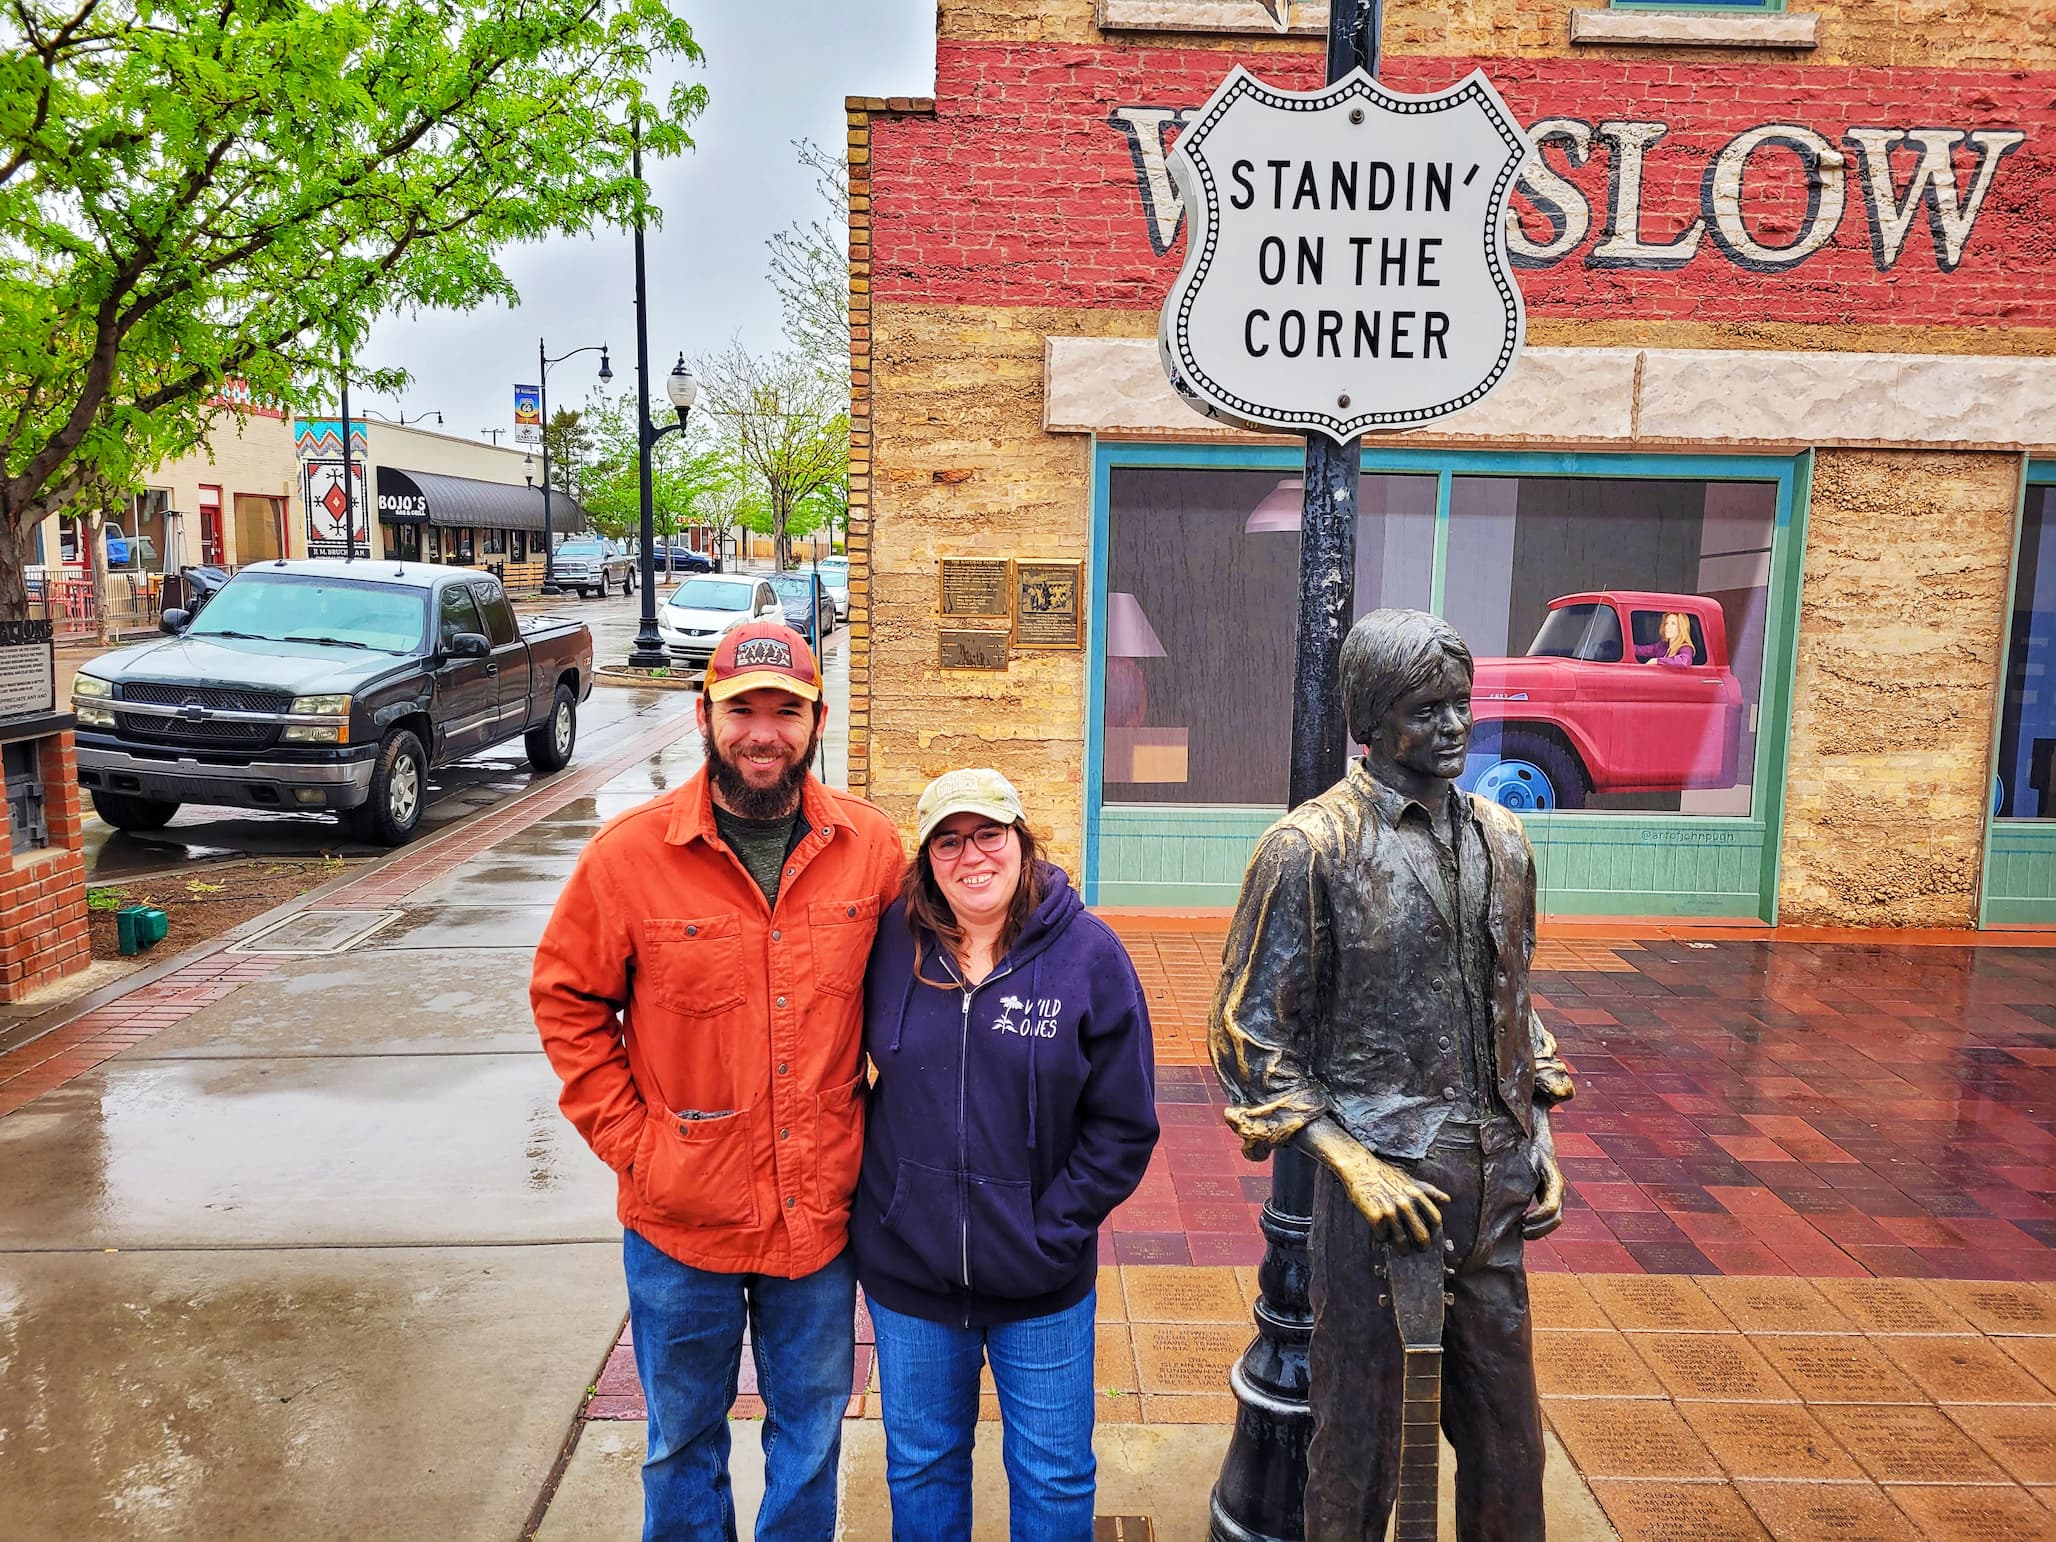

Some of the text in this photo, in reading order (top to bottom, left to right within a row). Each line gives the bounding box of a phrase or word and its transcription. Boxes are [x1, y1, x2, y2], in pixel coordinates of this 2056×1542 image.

[1110, 106, 2027, 275] WSLOW
[1230, 159, 1480, 212] STANDIN'
[1259, 235, 1443, 287] ON THE
[1244, 308, 1450, 359] CORNER
[378, 495, 427, 511] BOJO'S
[327, 548, 365, 557] BRUCHAN
[736, 656, 792, 666] BWCA
[1024, 999, 1061, 1018] WILD
[1020, 1018, 1058, 1039] ONES
